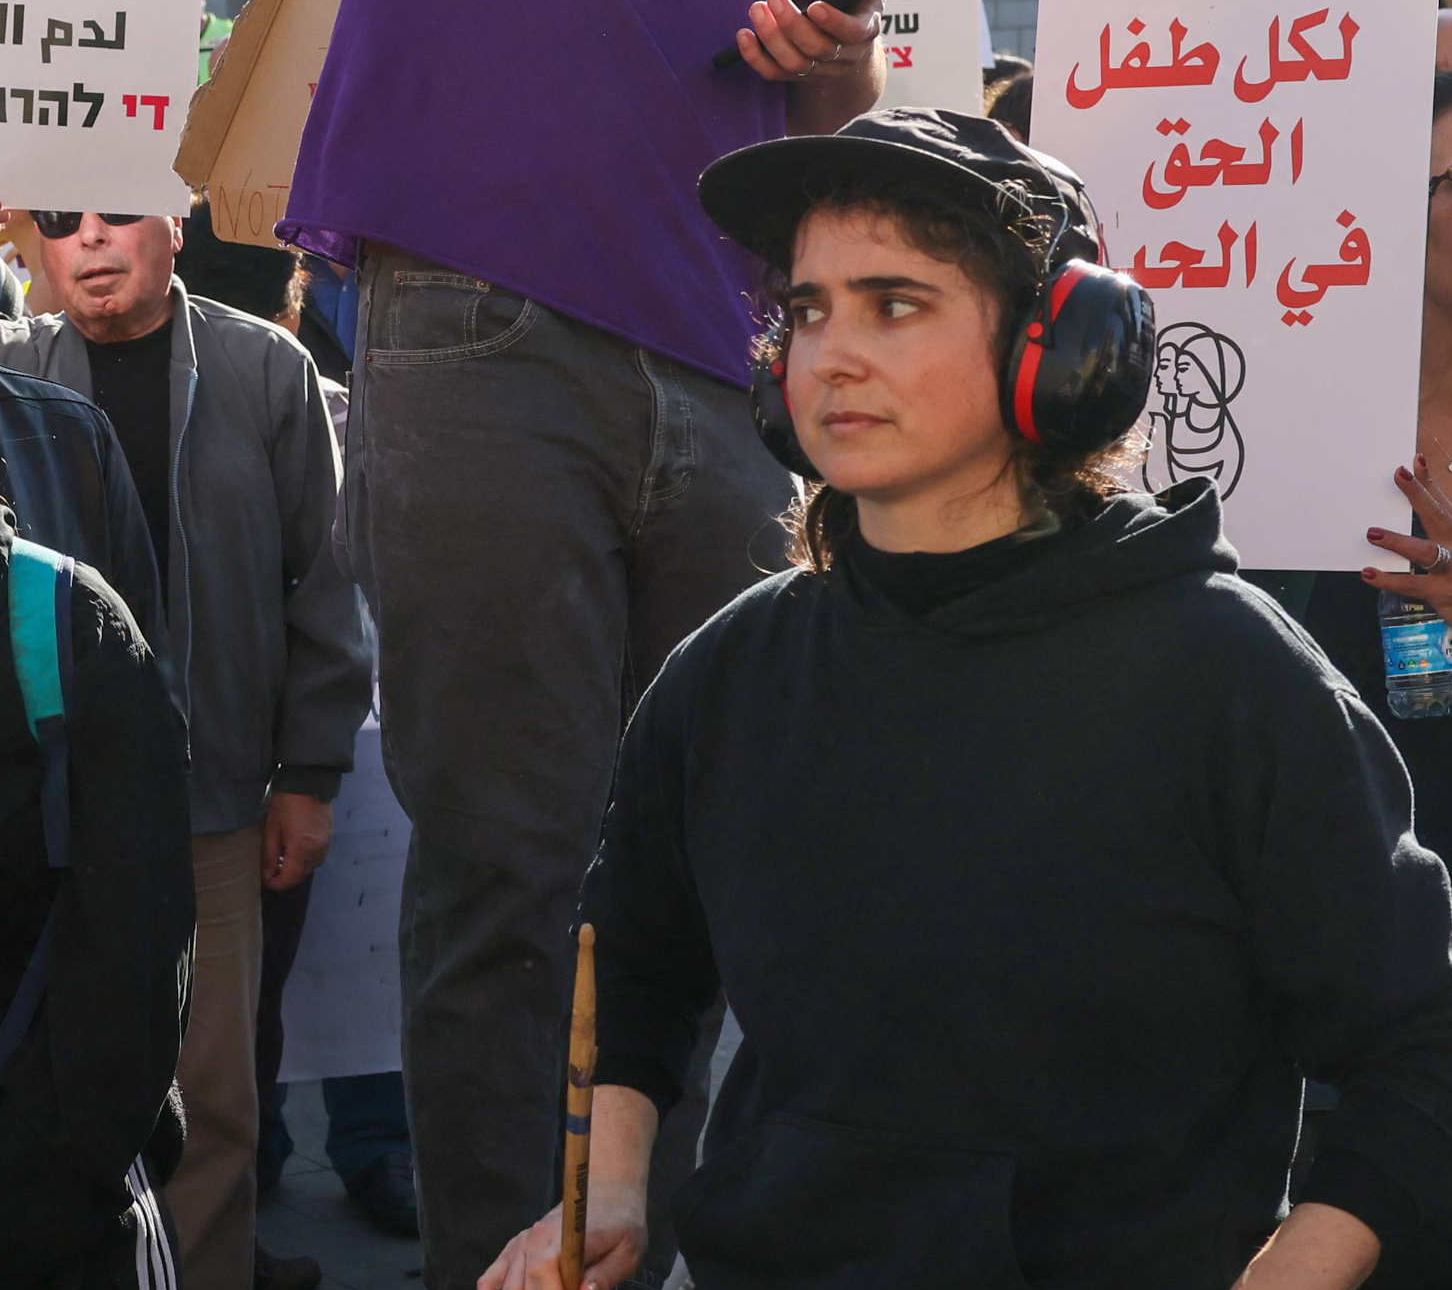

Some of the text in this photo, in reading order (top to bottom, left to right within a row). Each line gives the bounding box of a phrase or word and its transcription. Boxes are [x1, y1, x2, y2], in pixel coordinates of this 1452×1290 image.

[39, 9, 127, 64] لدم
[1065, 8, 1359, 109] لكل طفل
[121, 94, 170, 131] די
[1141, 117, 1304, 211] الحق
[1274, 207, 1373, 326] في
